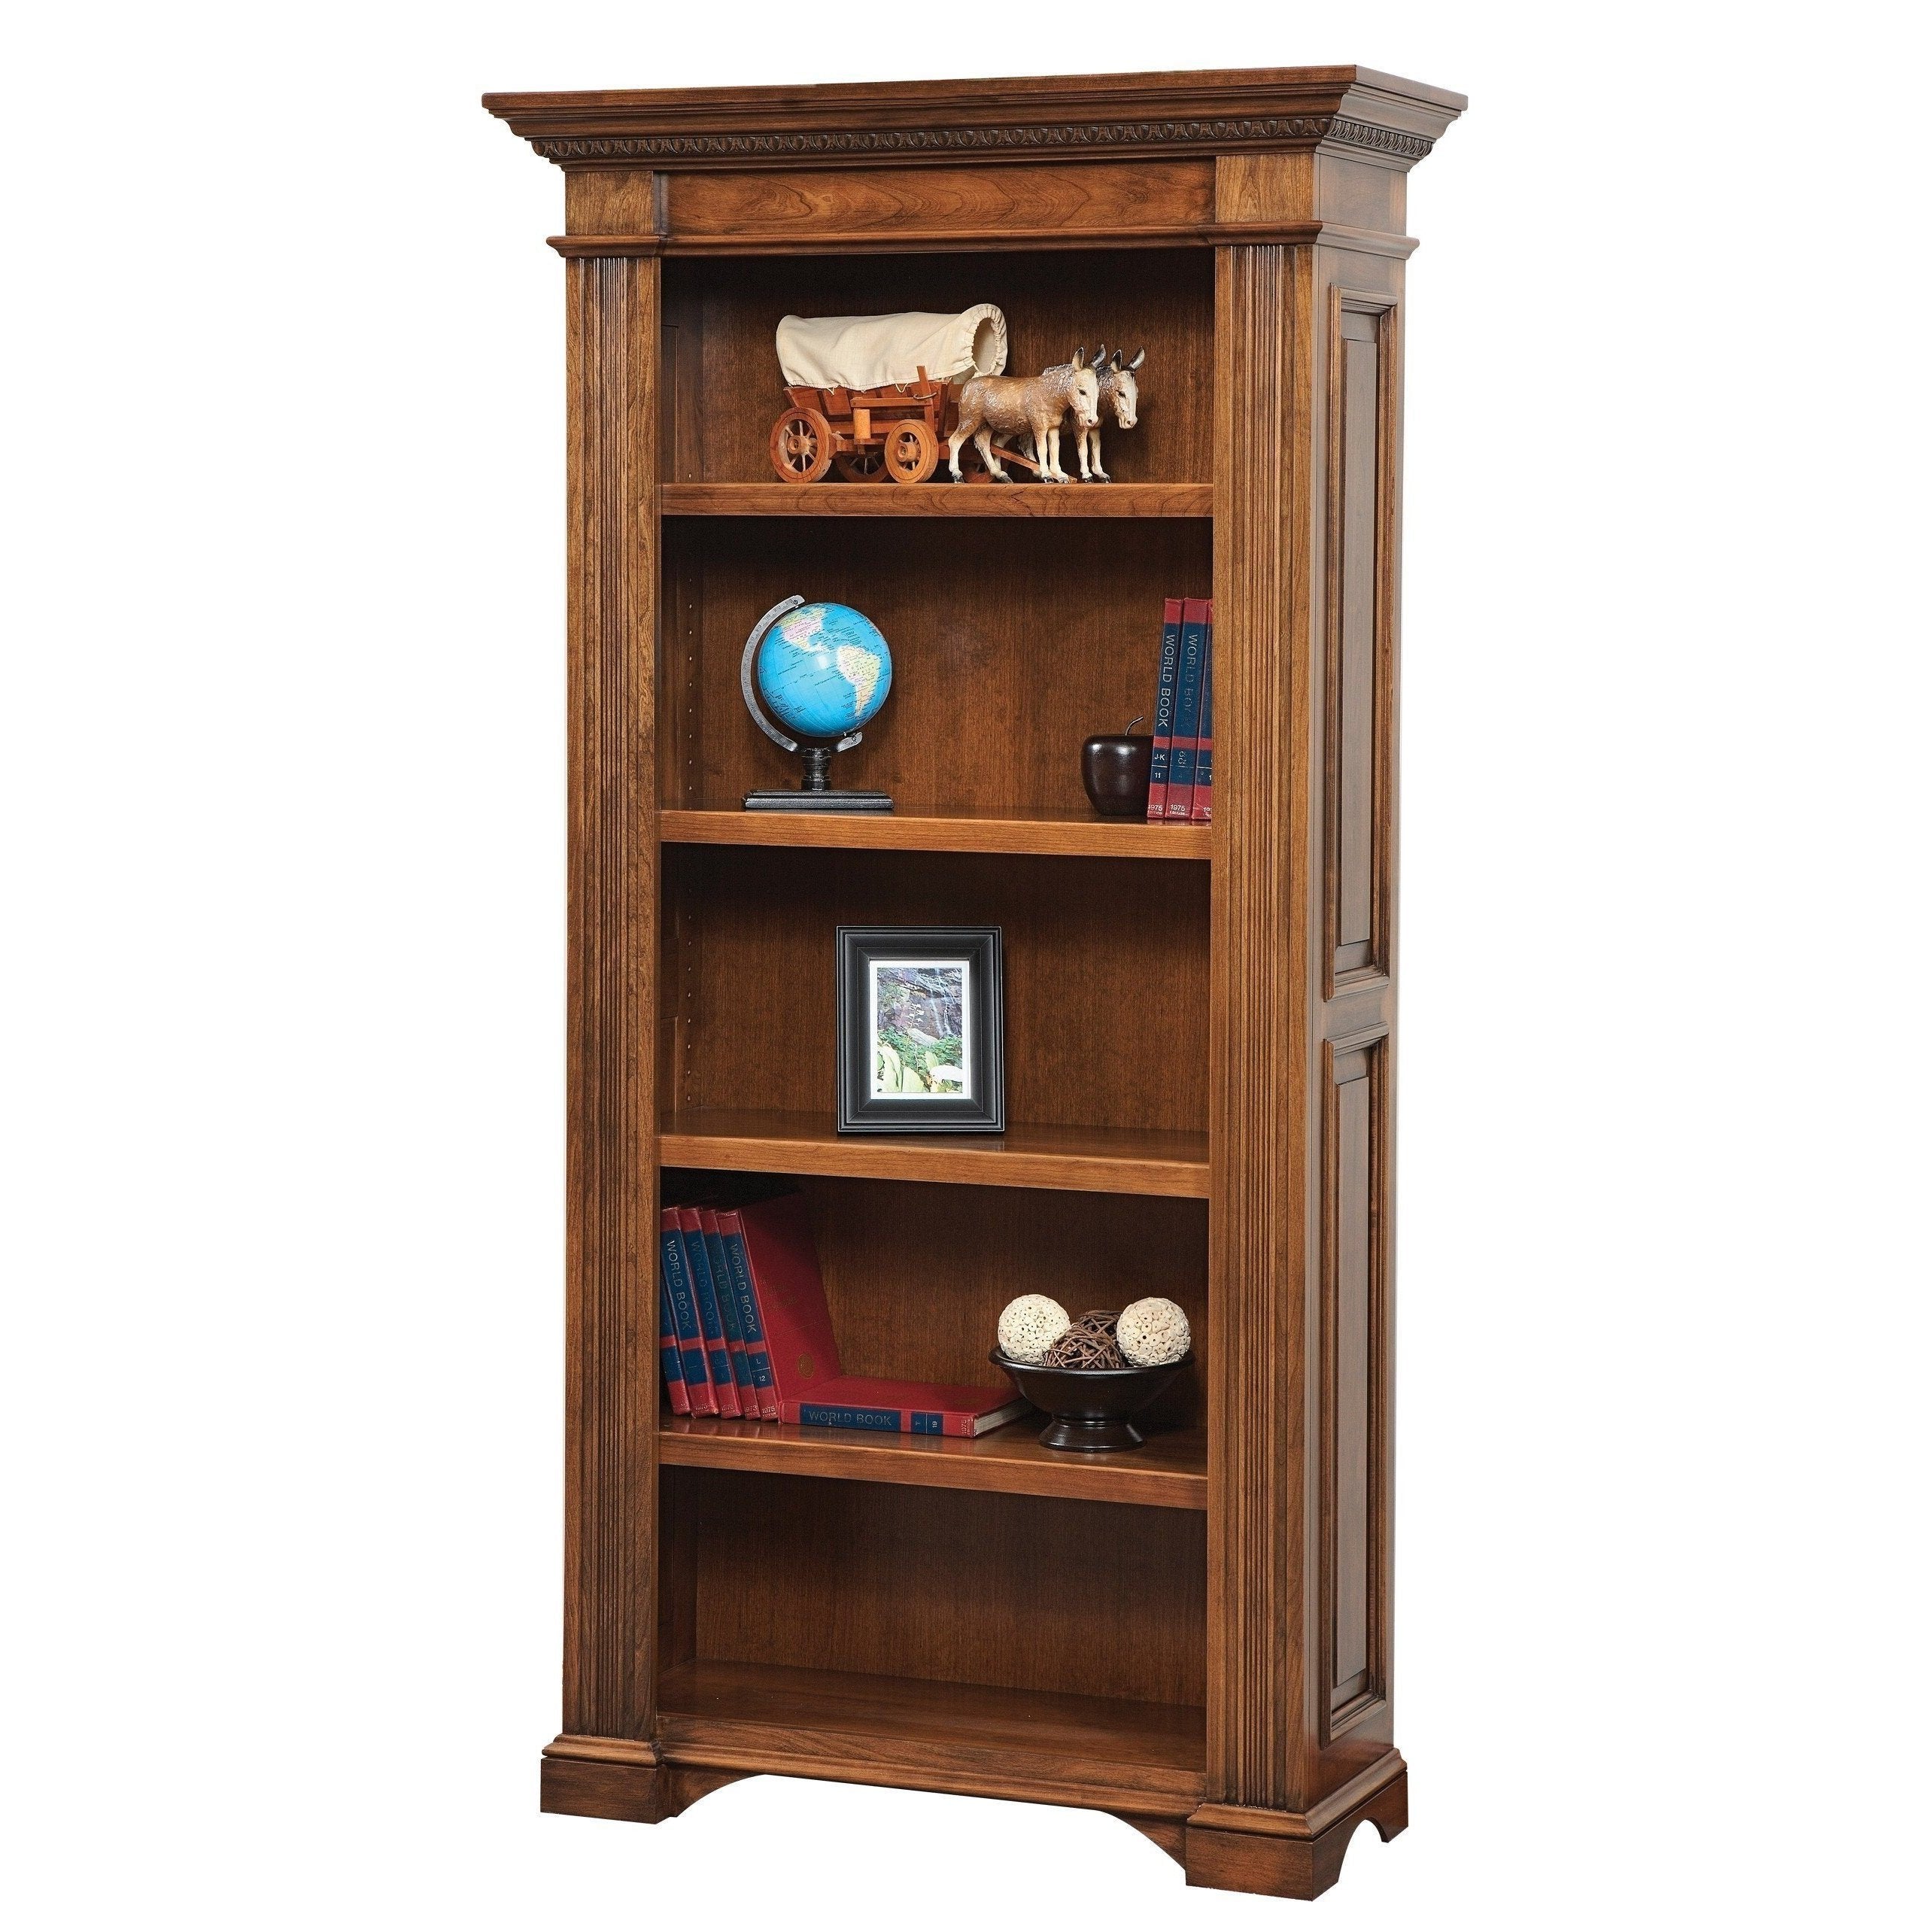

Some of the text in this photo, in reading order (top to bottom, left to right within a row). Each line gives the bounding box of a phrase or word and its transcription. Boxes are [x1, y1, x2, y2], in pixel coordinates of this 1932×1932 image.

[1185, 634, 1198, 683] WORLD
[1159, 634, 1175, 728] WORLD BOOK
[1147, 803, 1163, 813] 1975
[1170, 803, 1186, 812] 1975
[667, 1240, 691, 1330] WORLD BOOK
[731, 1243, 757, 1333] WORLD BOOK
[761, 1405, 776, 1414] 1975
[808, 1410, 892, 1426] WORLD BOOK
